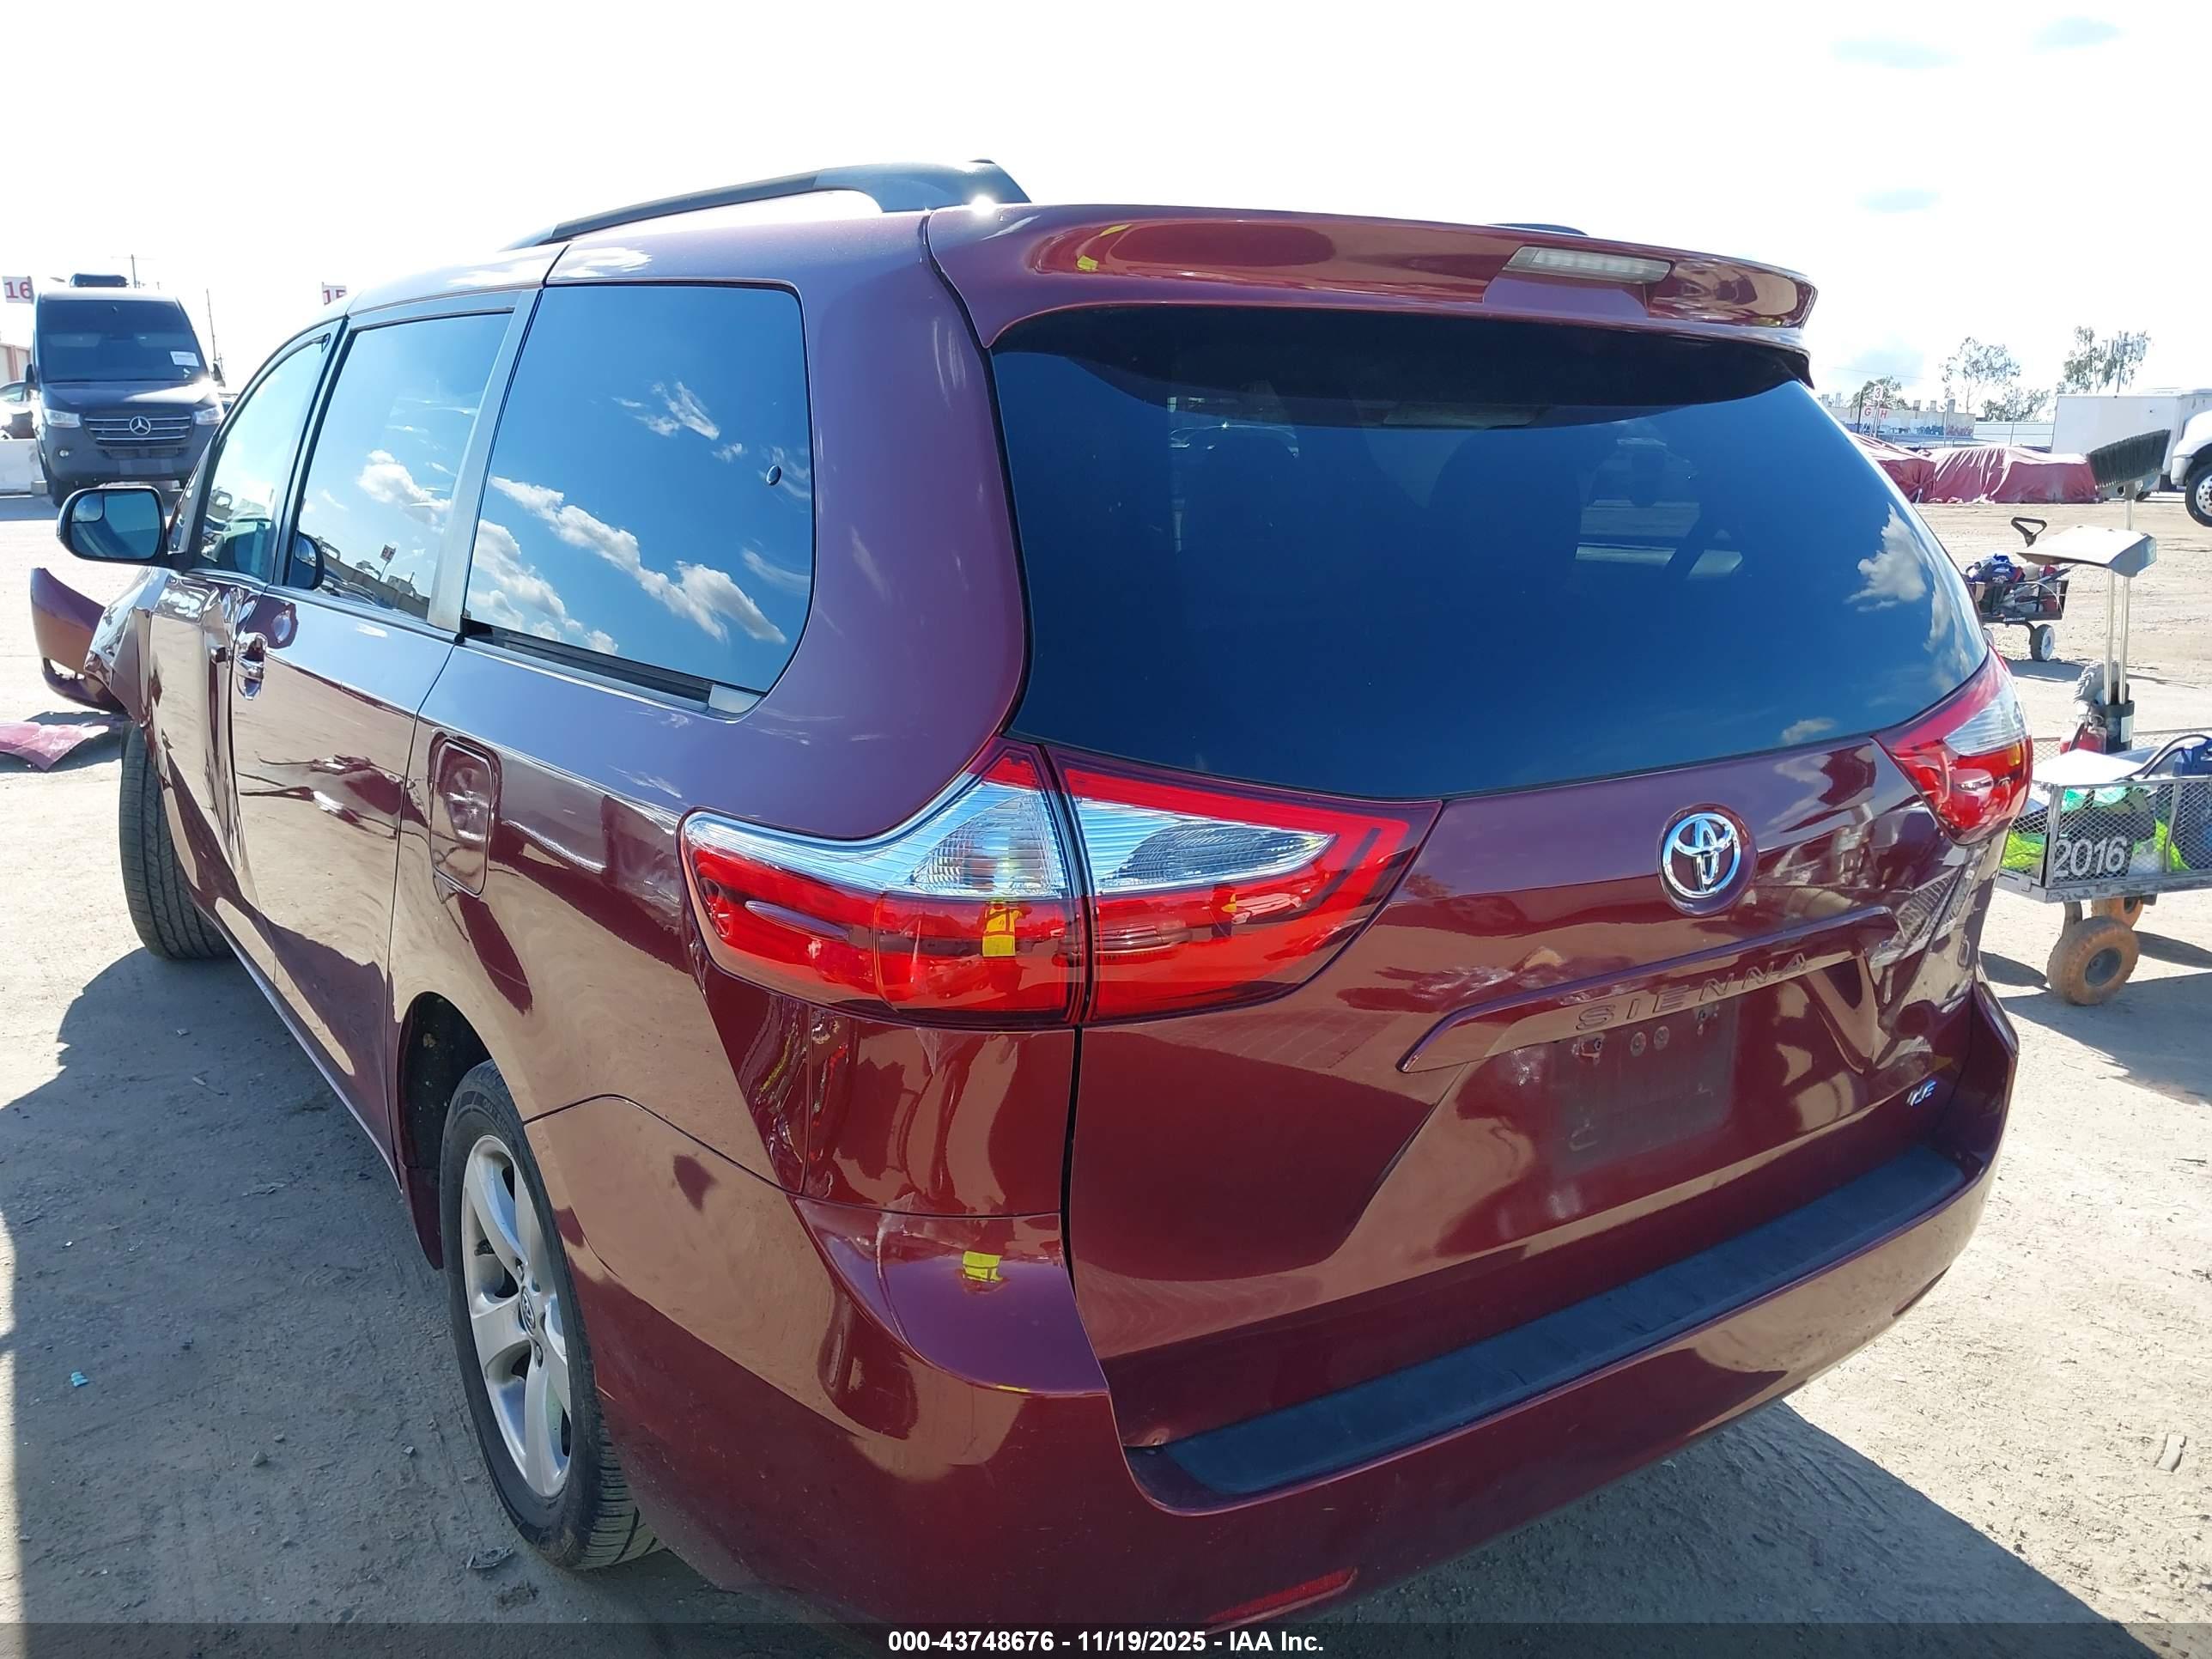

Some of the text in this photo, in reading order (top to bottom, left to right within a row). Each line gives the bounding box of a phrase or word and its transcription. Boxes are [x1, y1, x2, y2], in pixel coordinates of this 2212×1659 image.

[4, 282, 32, 299] 16
[1875, 387, 1881, 398] 3
[1864, 407, 1872, 416] G
[1880, 408, 1887, 418] H
[2054, 836, 2127, 877] 2016
[1575, 952, 1808, 1030] SIENNA
